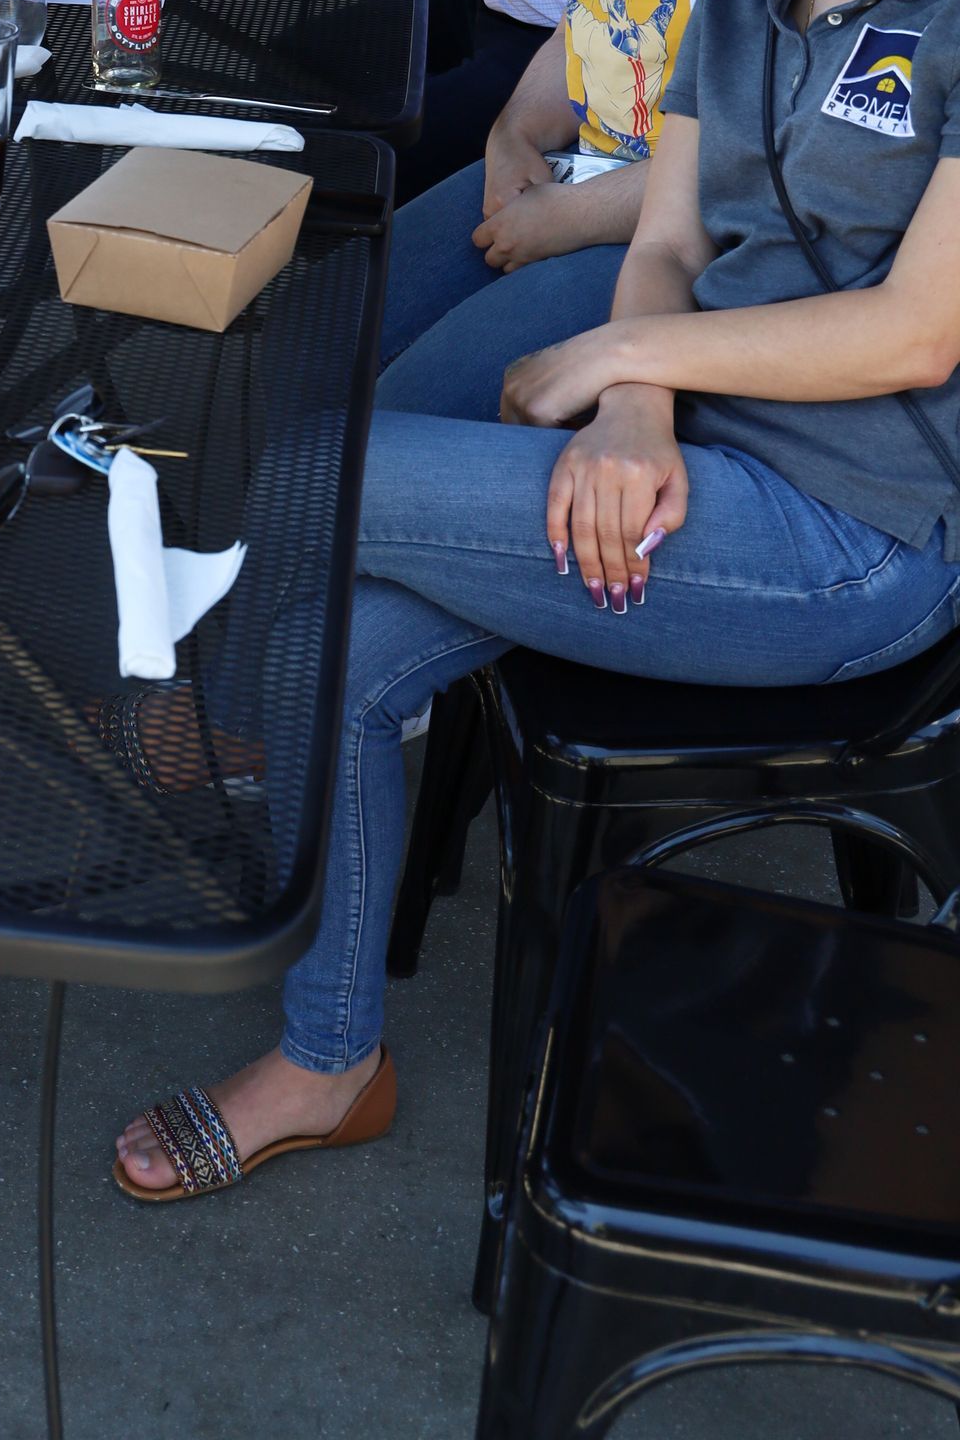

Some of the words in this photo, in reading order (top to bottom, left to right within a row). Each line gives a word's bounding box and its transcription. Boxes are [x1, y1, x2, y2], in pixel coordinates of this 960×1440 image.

[124, 3, 157, 16] SHIRLEY
[124, 15, 157, 26] TEMPLE
[111, 25, 157, 50] BOTTLING
[831, 85, 904, 119] HOME
[826, 101, 908, 133] REALTY
